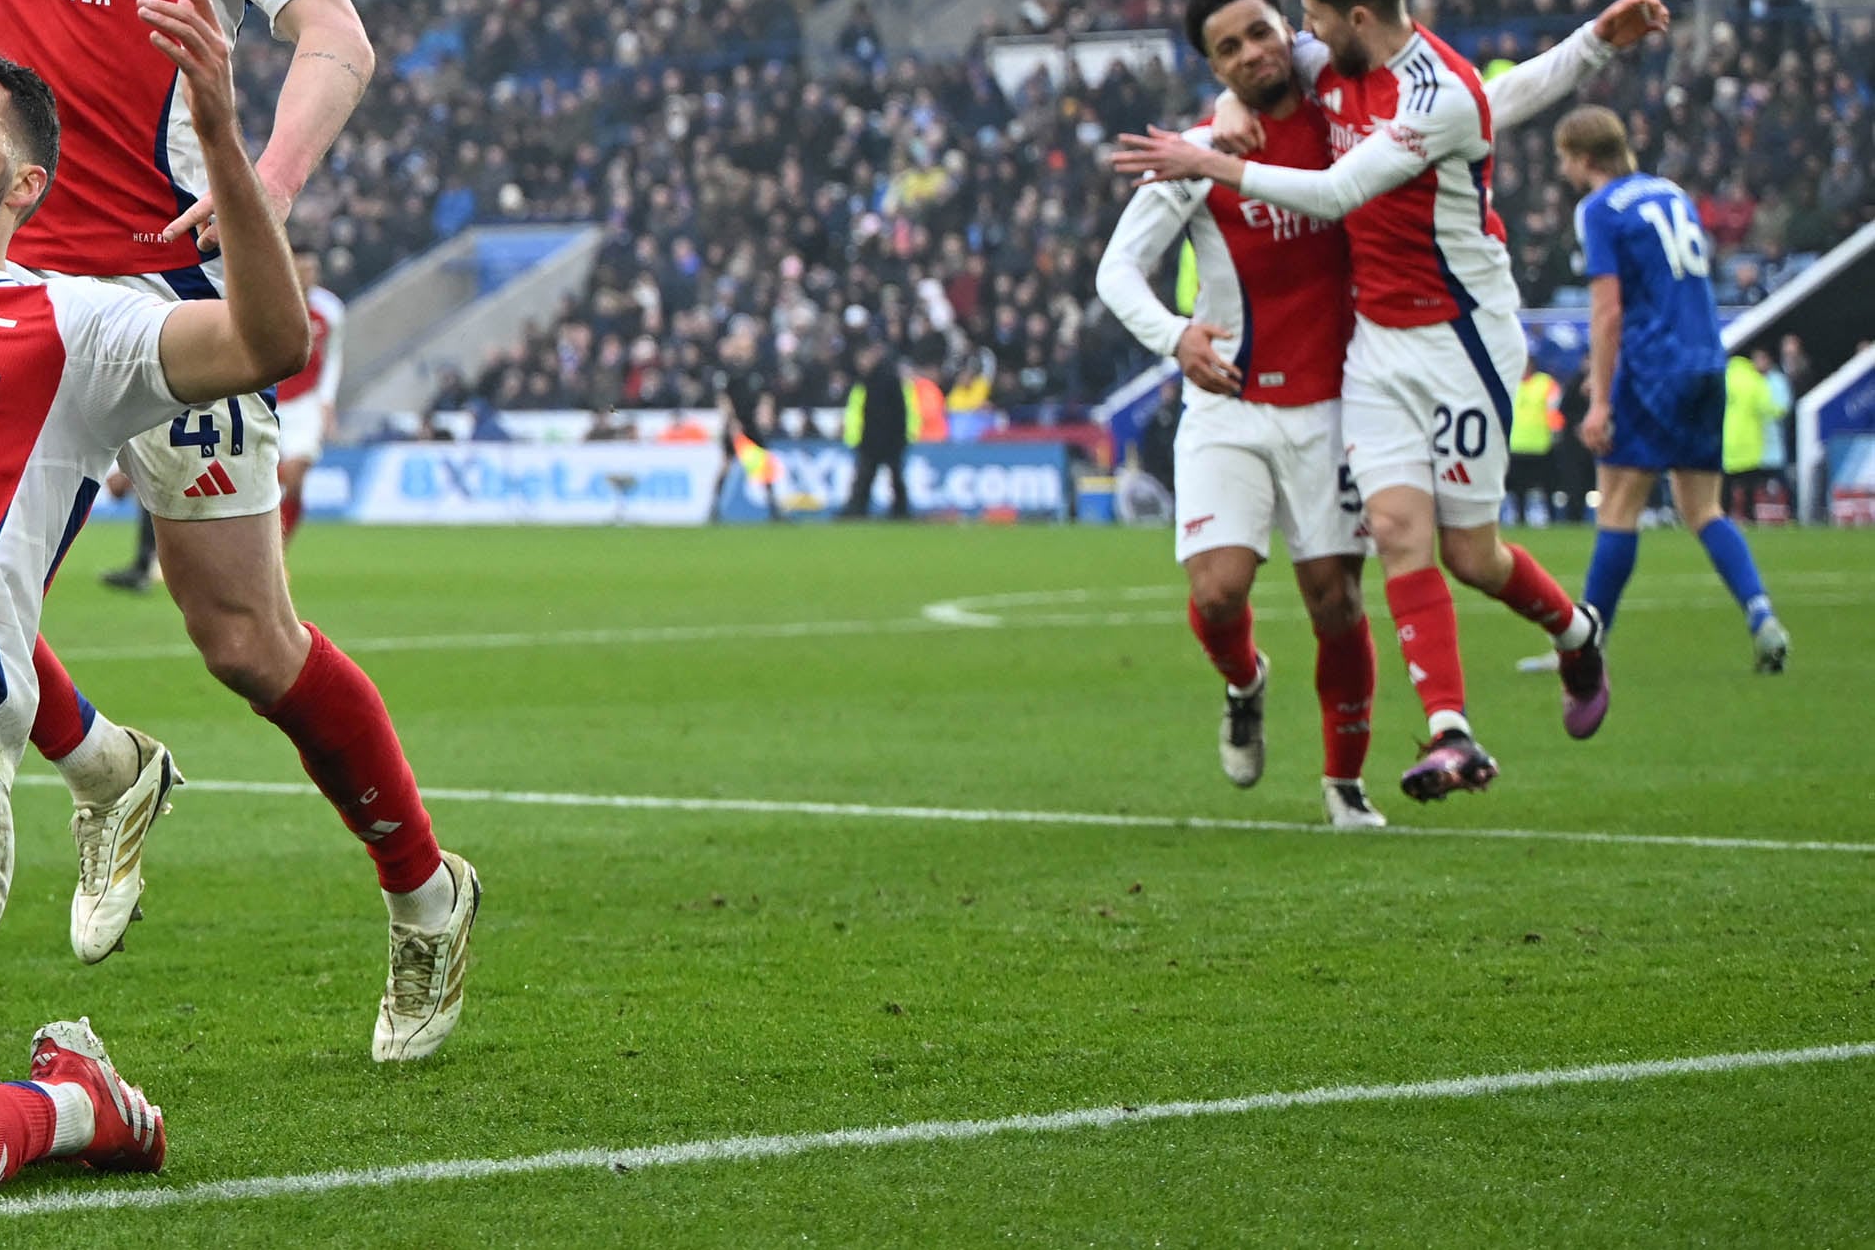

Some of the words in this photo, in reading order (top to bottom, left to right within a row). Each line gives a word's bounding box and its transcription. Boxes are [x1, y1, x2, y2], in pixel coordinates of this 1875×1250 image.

[1637, 197, 1709, 281] 16
[170, 397, 244, 458] 41
[1434, 404, 1487, 458] 20
